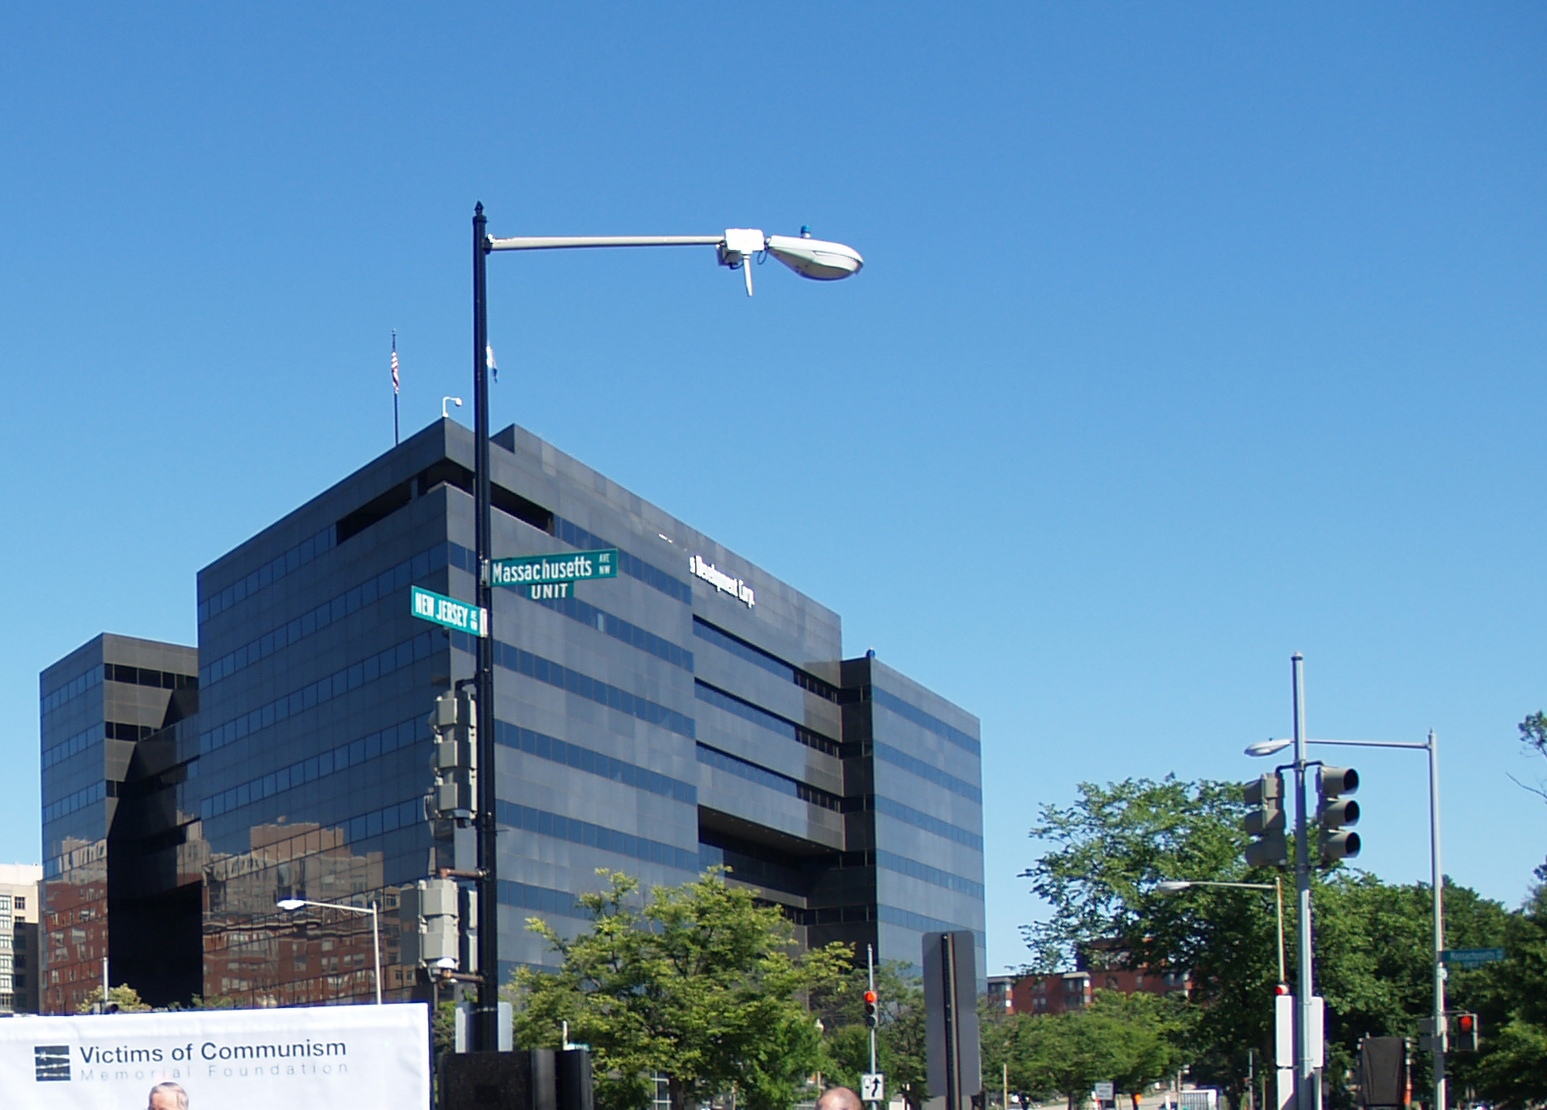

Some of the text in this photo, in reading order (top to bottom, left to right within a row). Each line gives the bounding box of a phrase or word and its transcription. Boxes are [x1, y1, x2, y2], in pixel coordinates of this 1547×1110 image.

[599, 553, 611, 563] AVE
[492, 556, 592, 584] Massachusetts
[599, 565, 611, 575] NW
[531, 583, 569, 600] UNIT
[415, 592, 468, 628] NEW JERSEY
[79, 1039, 347, 1064] Victims of Communism
[81, 1063, 348, 1082] Memorial Foundation
